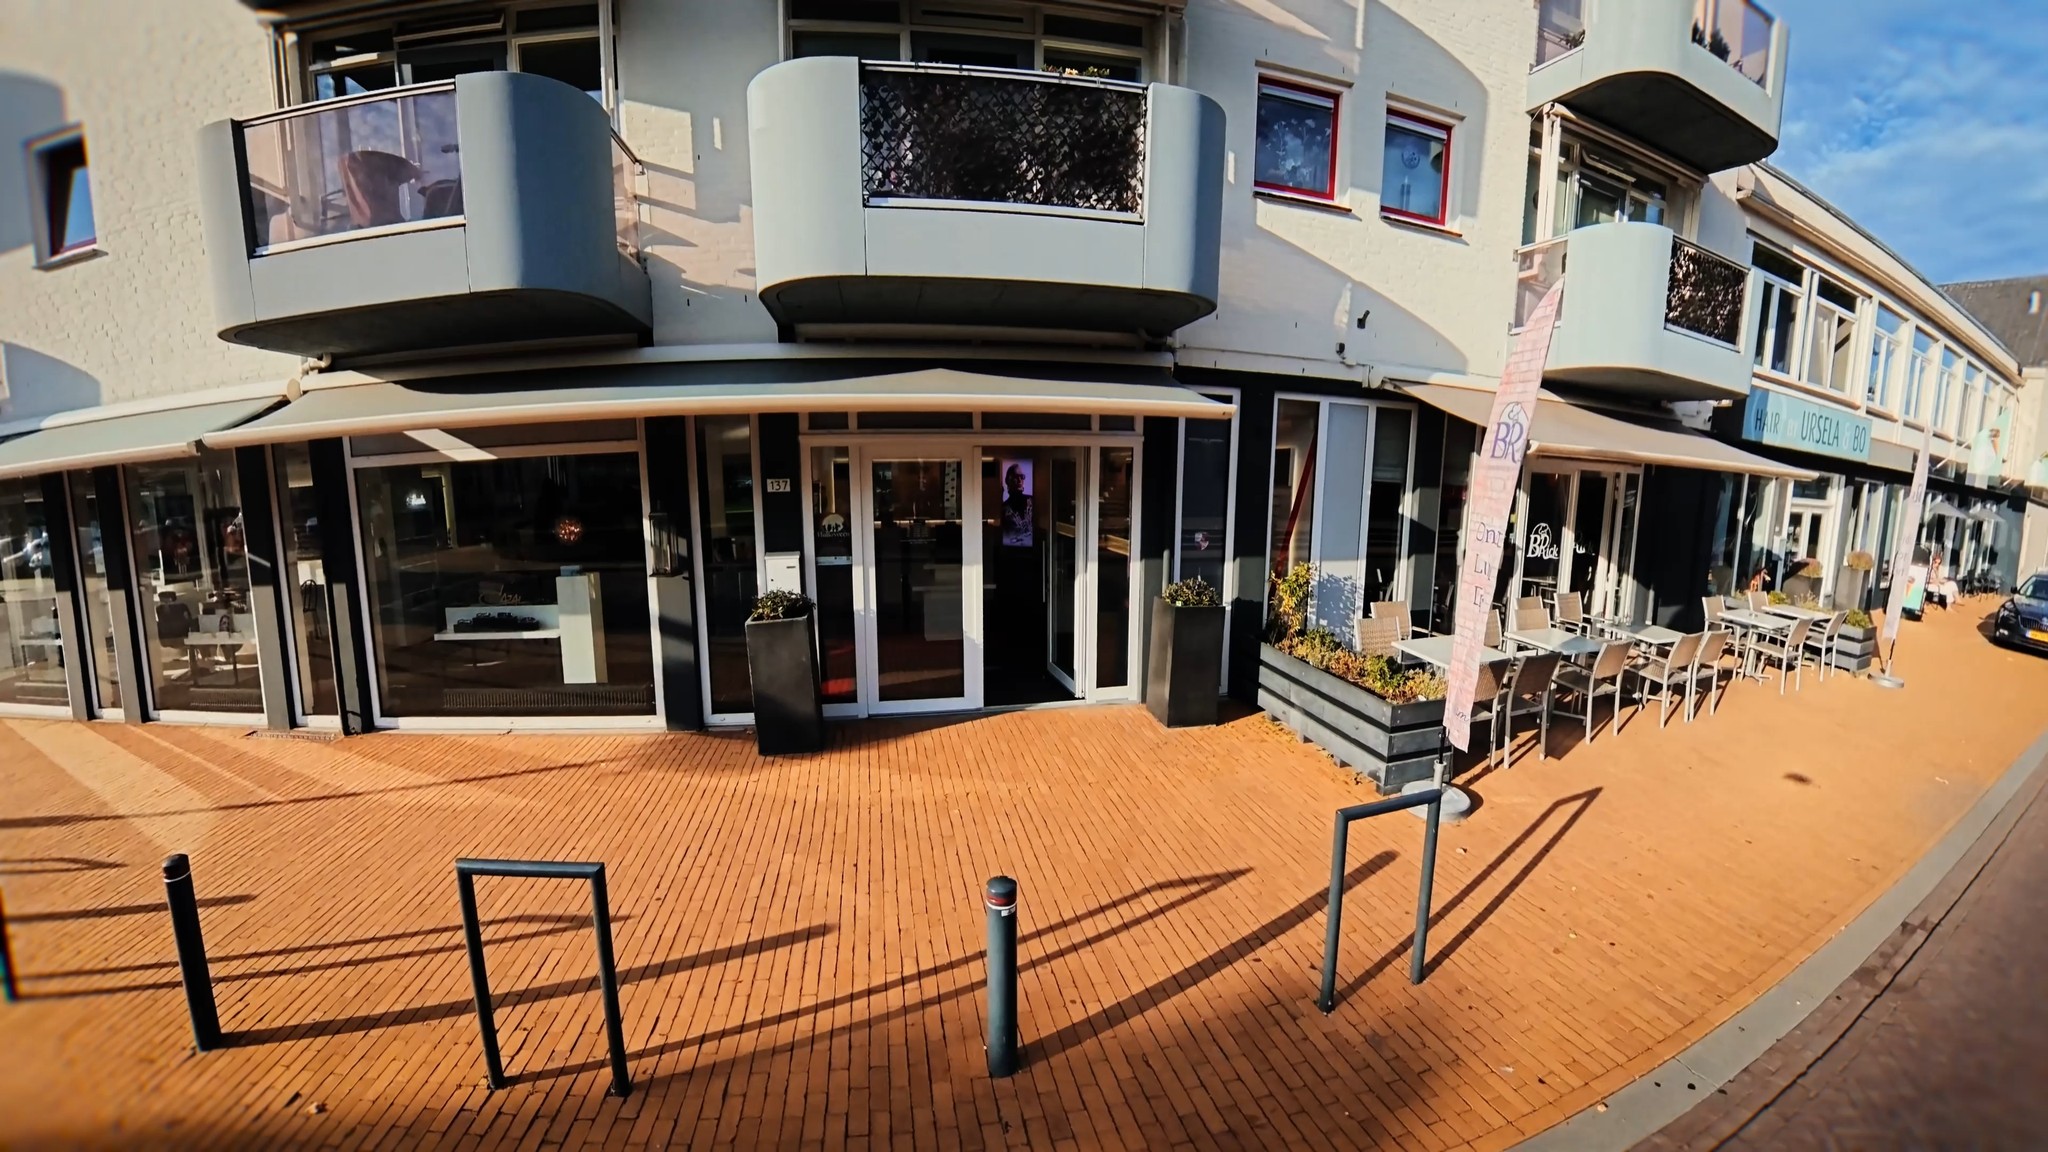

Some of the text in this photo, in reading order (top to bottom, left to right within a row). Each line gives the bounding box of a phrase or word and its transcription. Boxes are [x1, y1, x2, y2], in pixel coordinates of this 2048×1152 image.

[1754, 408, 1780, 434] HAIR
[1801, 410, 1840, 447] URSELA
[1852, 424, 1867, 453] BO
[770, 480, 788, 491] 137
